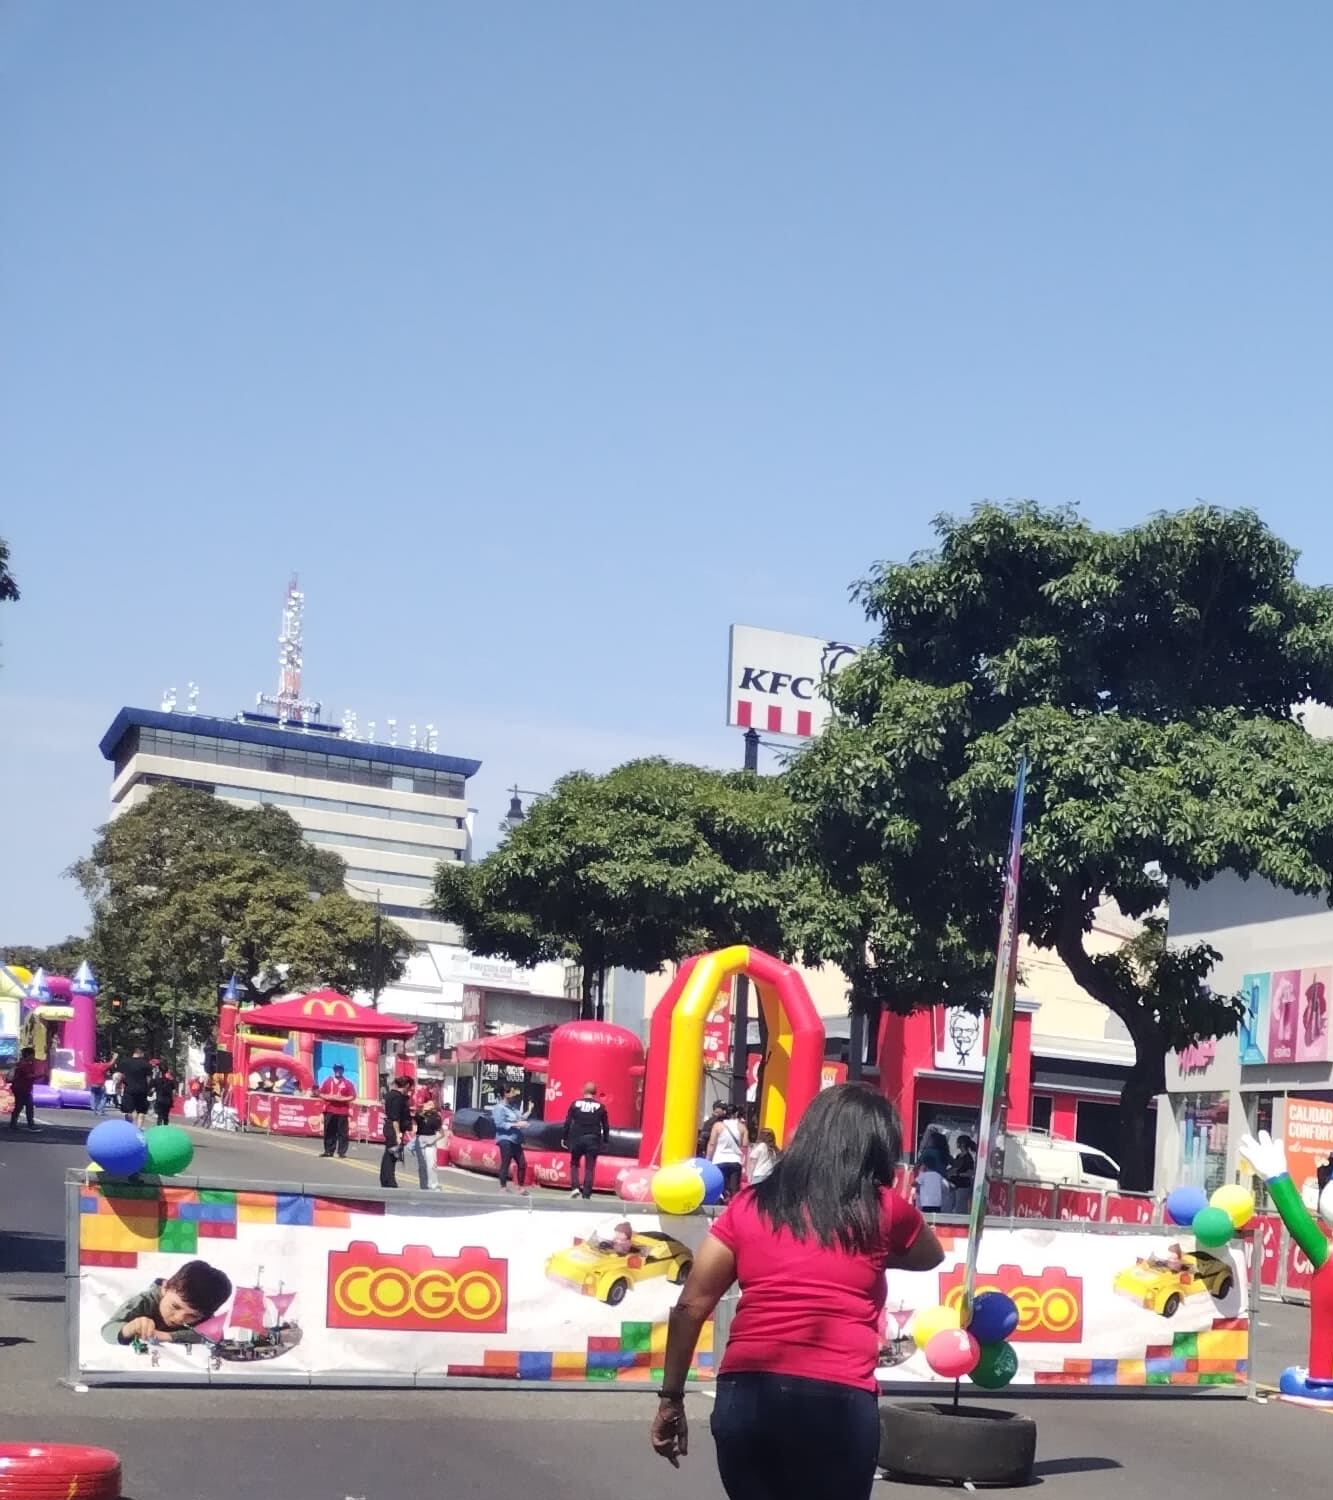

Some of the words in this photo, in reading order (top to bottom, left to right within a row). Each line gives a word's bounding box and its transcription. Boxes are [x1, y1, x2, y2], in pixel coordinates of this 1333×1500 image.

[739, 667, 815, 700] KFC
[1288, 1104, 1333, 1124] CALIDAD
[335, 1266, 501, 1320] COGO
